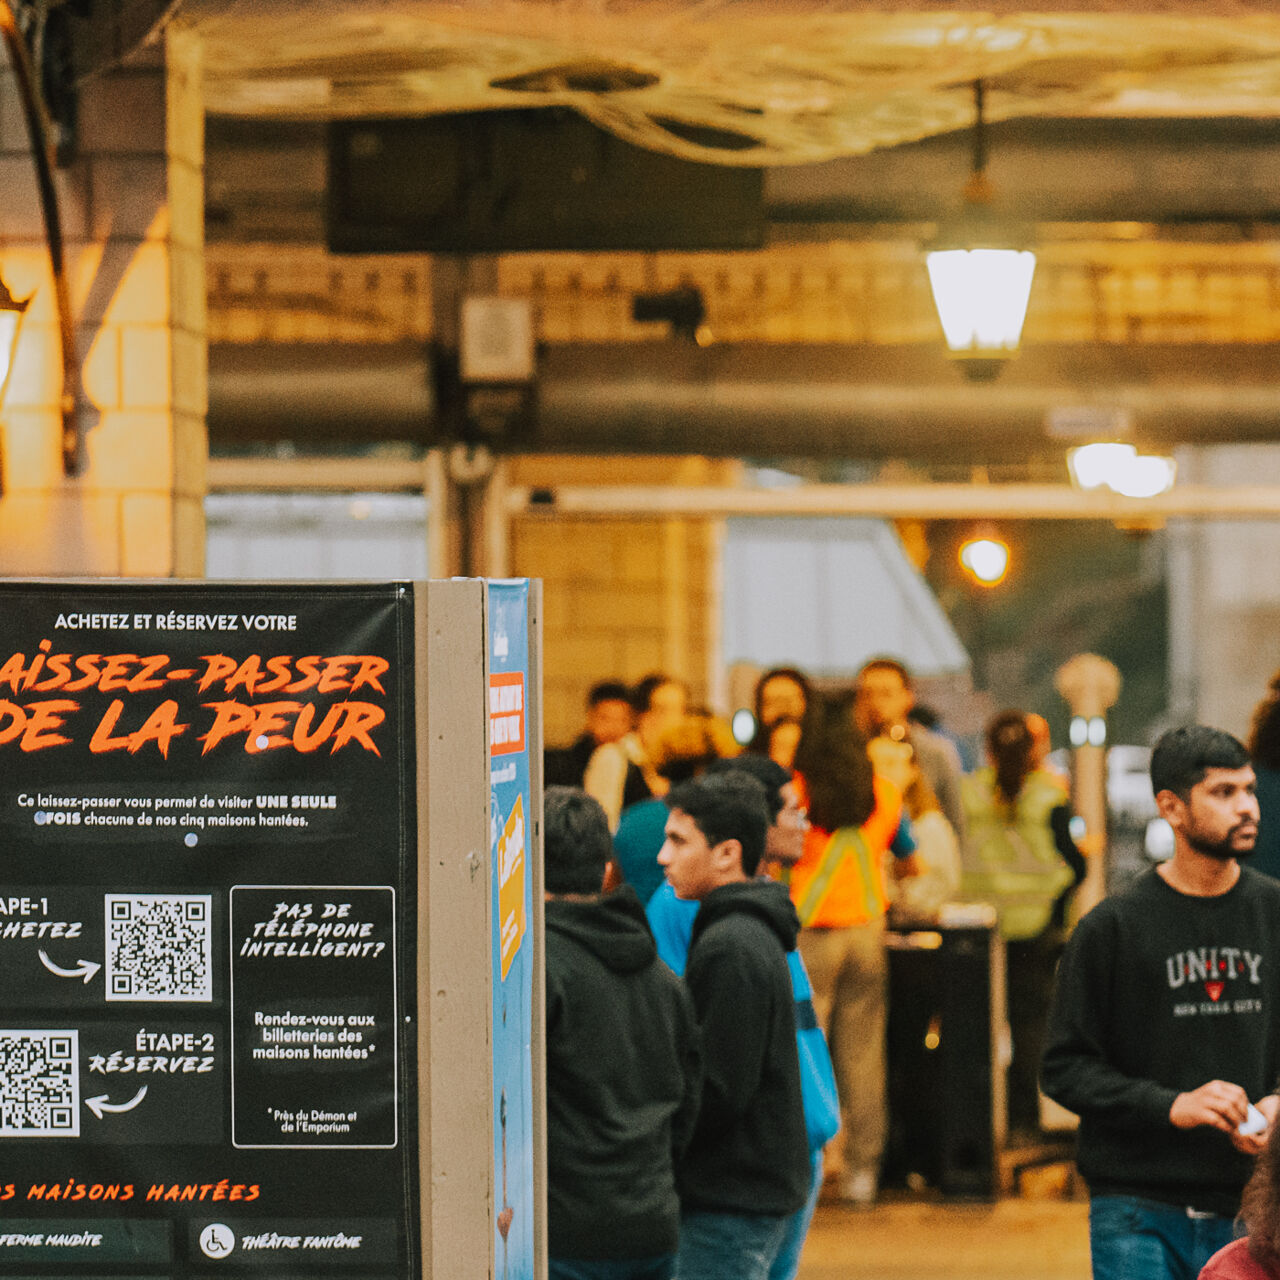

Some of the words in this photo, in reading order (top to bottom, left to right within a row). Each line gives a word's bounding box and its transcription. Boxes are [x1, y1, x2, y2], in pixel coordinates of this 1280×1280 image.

[55, 614, 129, 629] ACHETEZ
[134, 614, 152, 629] ET
[156, 610, 238, 630] RÉSERVEZ
[242, 615, 296, 630] VOTRE
[89, 699, 189, 760] LA
[197, 698, 385, 757] PEUR
[18, 794, 34, 806] Ce
[38, 793, 121, 810] laissez-passer
[124, 799, 152, 807] vous
[155, 797, 197, 810] permet
[200, 794, 214, 808] de
[218, 796, 253, 808] visiter
[256, 796, 288, 808] UNE
[292, 796, 336, 808] SEULE
[46, 811, 81, 825] FOIS
[84, 812, 134, 826] chacune
[137, 812, 152, 825] de
[156, 814, 177, 825] nos
[180, 813, 205, 829] cinq
[208, 813, 257, 826] maisons
[259, 812, 309, 827] hantées.
[272, 902, 312, 921] PAS
[321, 904, 351, 918] DE
[0, 922, 82, 938] HETEZ
[254, 917, 373, 938] TÉLÉPHONE
[1166, 946, 1263, 989] UNITY
[255, 1011, 344, 1026] Rendez-vous
[348, 1016, 375, 1025] aux
[136, 1029, 215, 1052] ÉTAPE-2
[263, 1028, 334, 1042] billetteries
[338, 1028, 362, 1042] des
[253, 1045, 310, 1058] maisons
[89, 1050, 214, 1074] RÉSERVEZ
[296, 1110, 309, 1121] du
[311, 1110, 346, 1122] Démon
[348, 1112, 357, 1121] et
[281, 1121, 294, 1132] de
[0, 1184, 15, 1200] S
[27, 1178, 134, 1200] MAISONS
[146, 1179, 259, 1201] HANTÉES
[45, 1231, 102, 1246] MAUDITE
[242, 1232, 301, 1250] THÉÂTRE
[303, 1233, 362, 1248] FANTÔME
